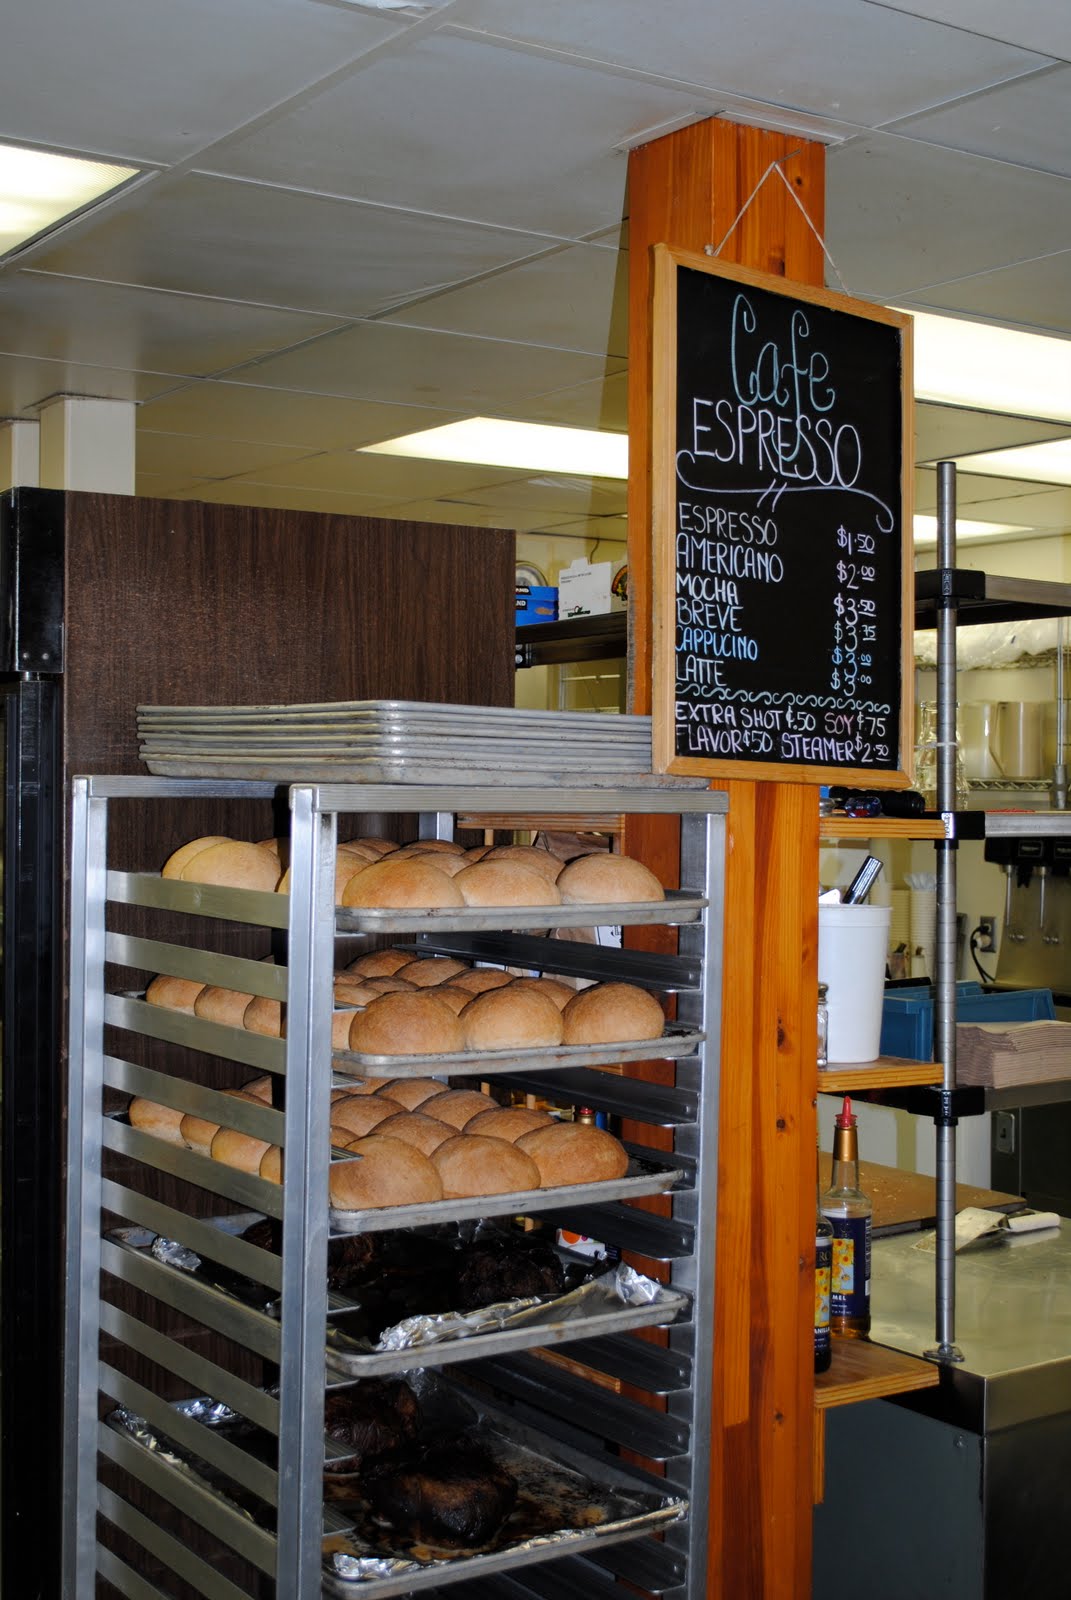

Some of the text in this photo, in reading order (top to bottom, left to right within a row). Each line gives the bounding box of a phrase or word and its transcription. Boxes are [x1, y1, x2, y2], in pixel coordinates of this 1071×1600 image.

[731, 293, 835, 462] Cafe
[693, 398, 861, 488] ESPRESSO
[679, 502, 778, 546] ESPRESSO
[676, 532, 784, 583] AMERICANO
[676, 572, 739, 606] MOCHA
[676, 598, 744, 632] BREVE
[676, 625, 758, 661] CAPPUCINO
[676, 654, 727, 687] LATTE
[675, 700, 737, 728] EXTRA
[740, 707, 784, 731] SHOT
[824, 711, 854, 736] SOY
[675, 724, 744, 753] FLAVOR
[781, 732, 857, 761] STEAMER
[831, 1293, 847, 1301] MEL
